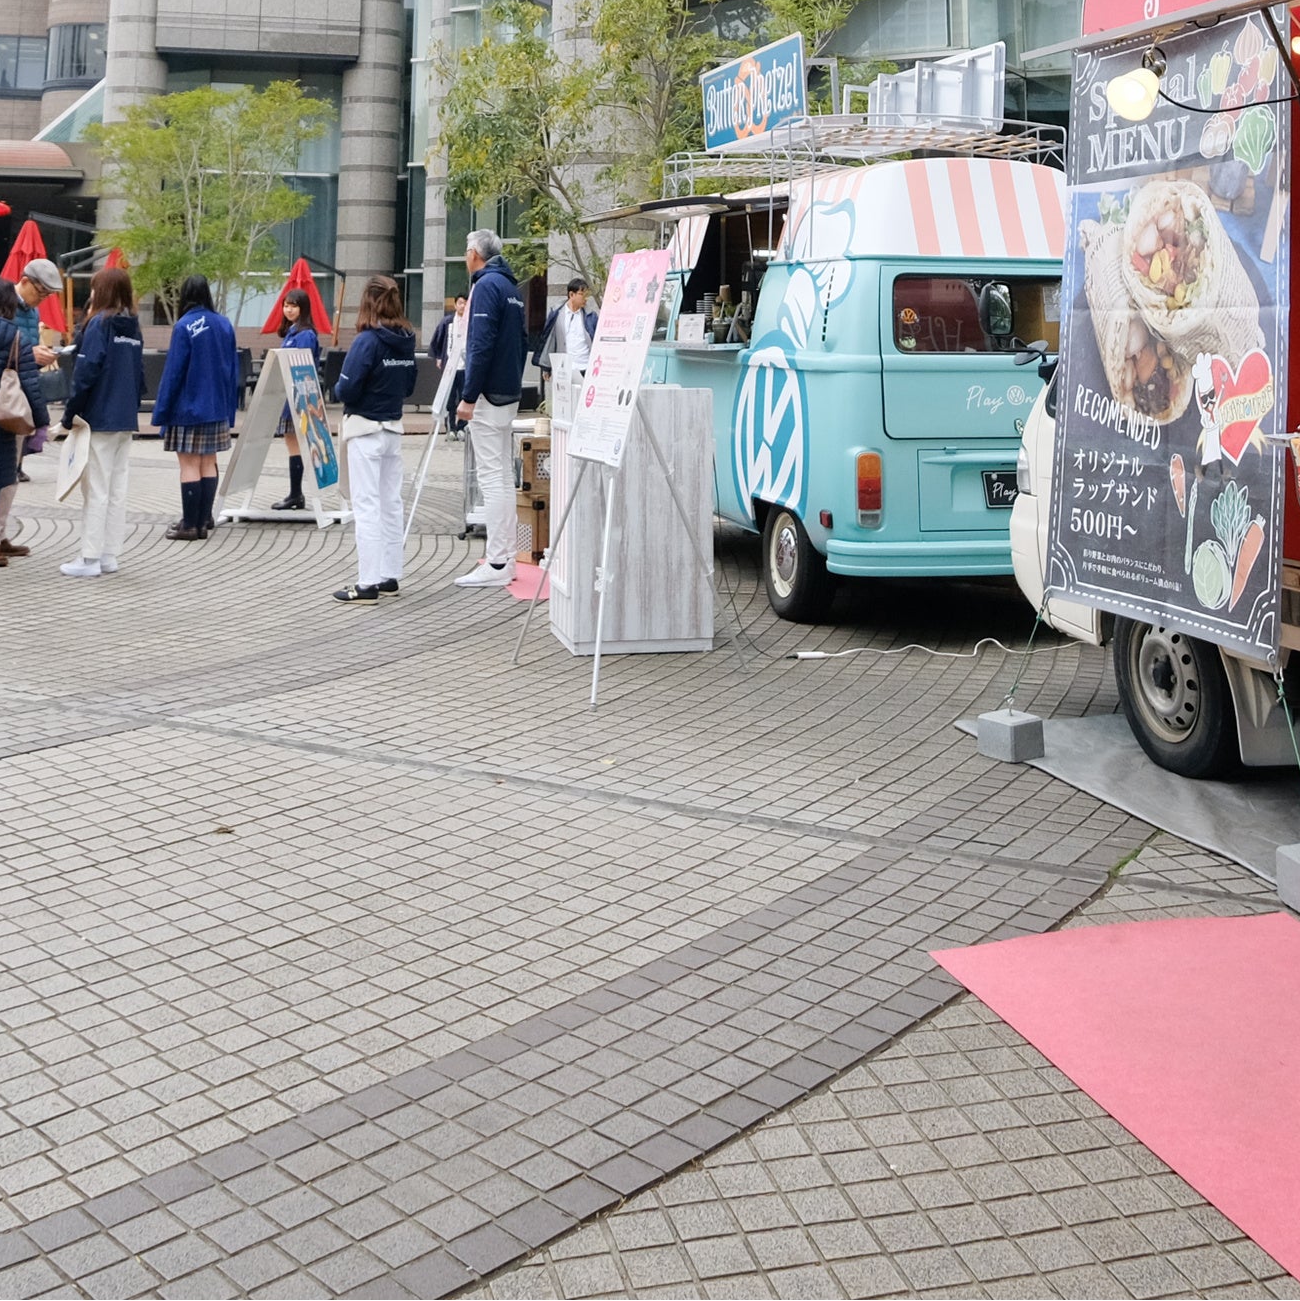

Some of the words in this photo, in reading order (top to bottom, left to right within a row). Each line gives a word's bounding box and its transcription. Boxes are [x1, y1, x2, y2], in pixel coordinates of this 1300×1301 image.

[1085, 114, 1191, 175] MENU
[965, 385, 1004, 415] Play
[1073, 382, 1162, 450] RECOMENDED
[1071, 448, 1143, 478] オリジナル
[1070, 476, 1159, 511] ラップサンド
